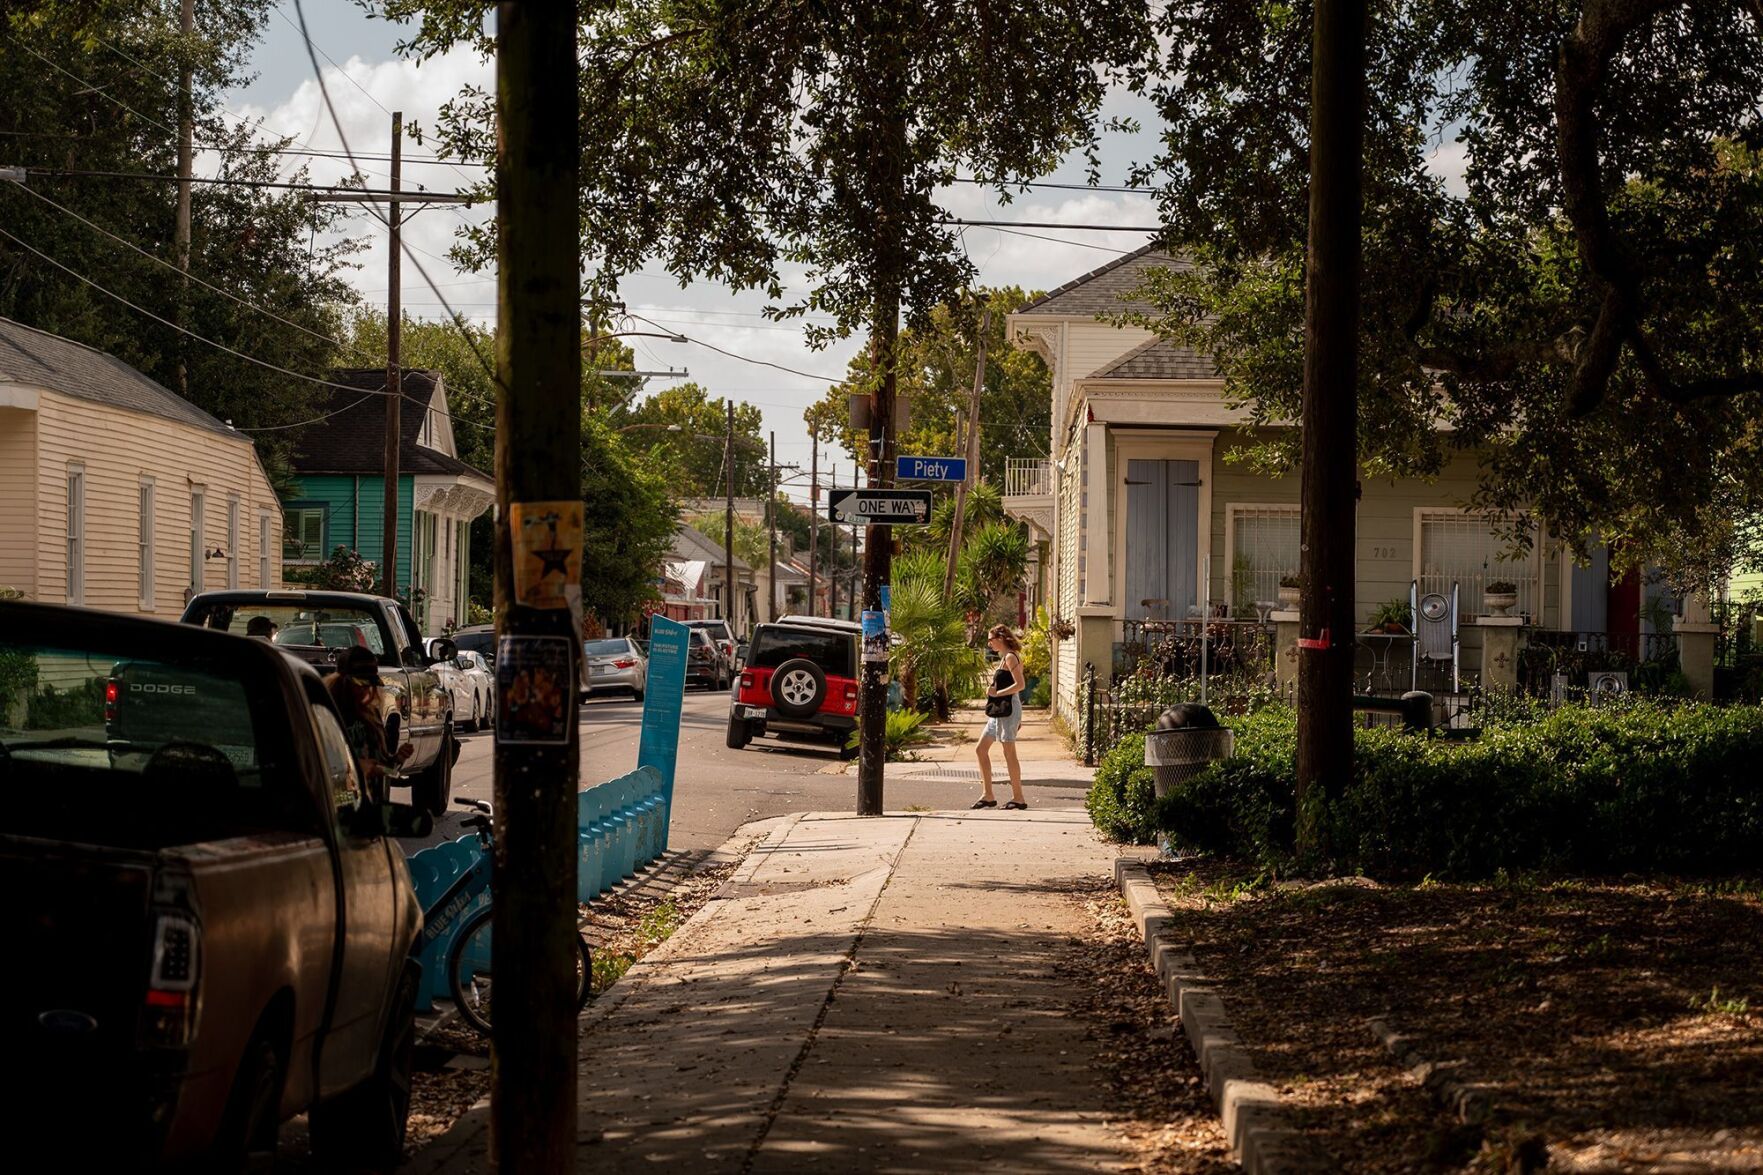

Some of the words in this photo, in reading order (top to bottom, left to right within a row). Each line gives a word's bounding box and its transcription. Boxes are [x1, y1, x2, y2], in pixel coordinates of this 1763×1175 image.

[914, 460, 949, 480] Piety
[859, 501, 886, 514] ONE
[1373, 547, 1397, 559] 702
[130, 683, 196, 695] DODGE
[425, 914, 449, 940] BLUE
